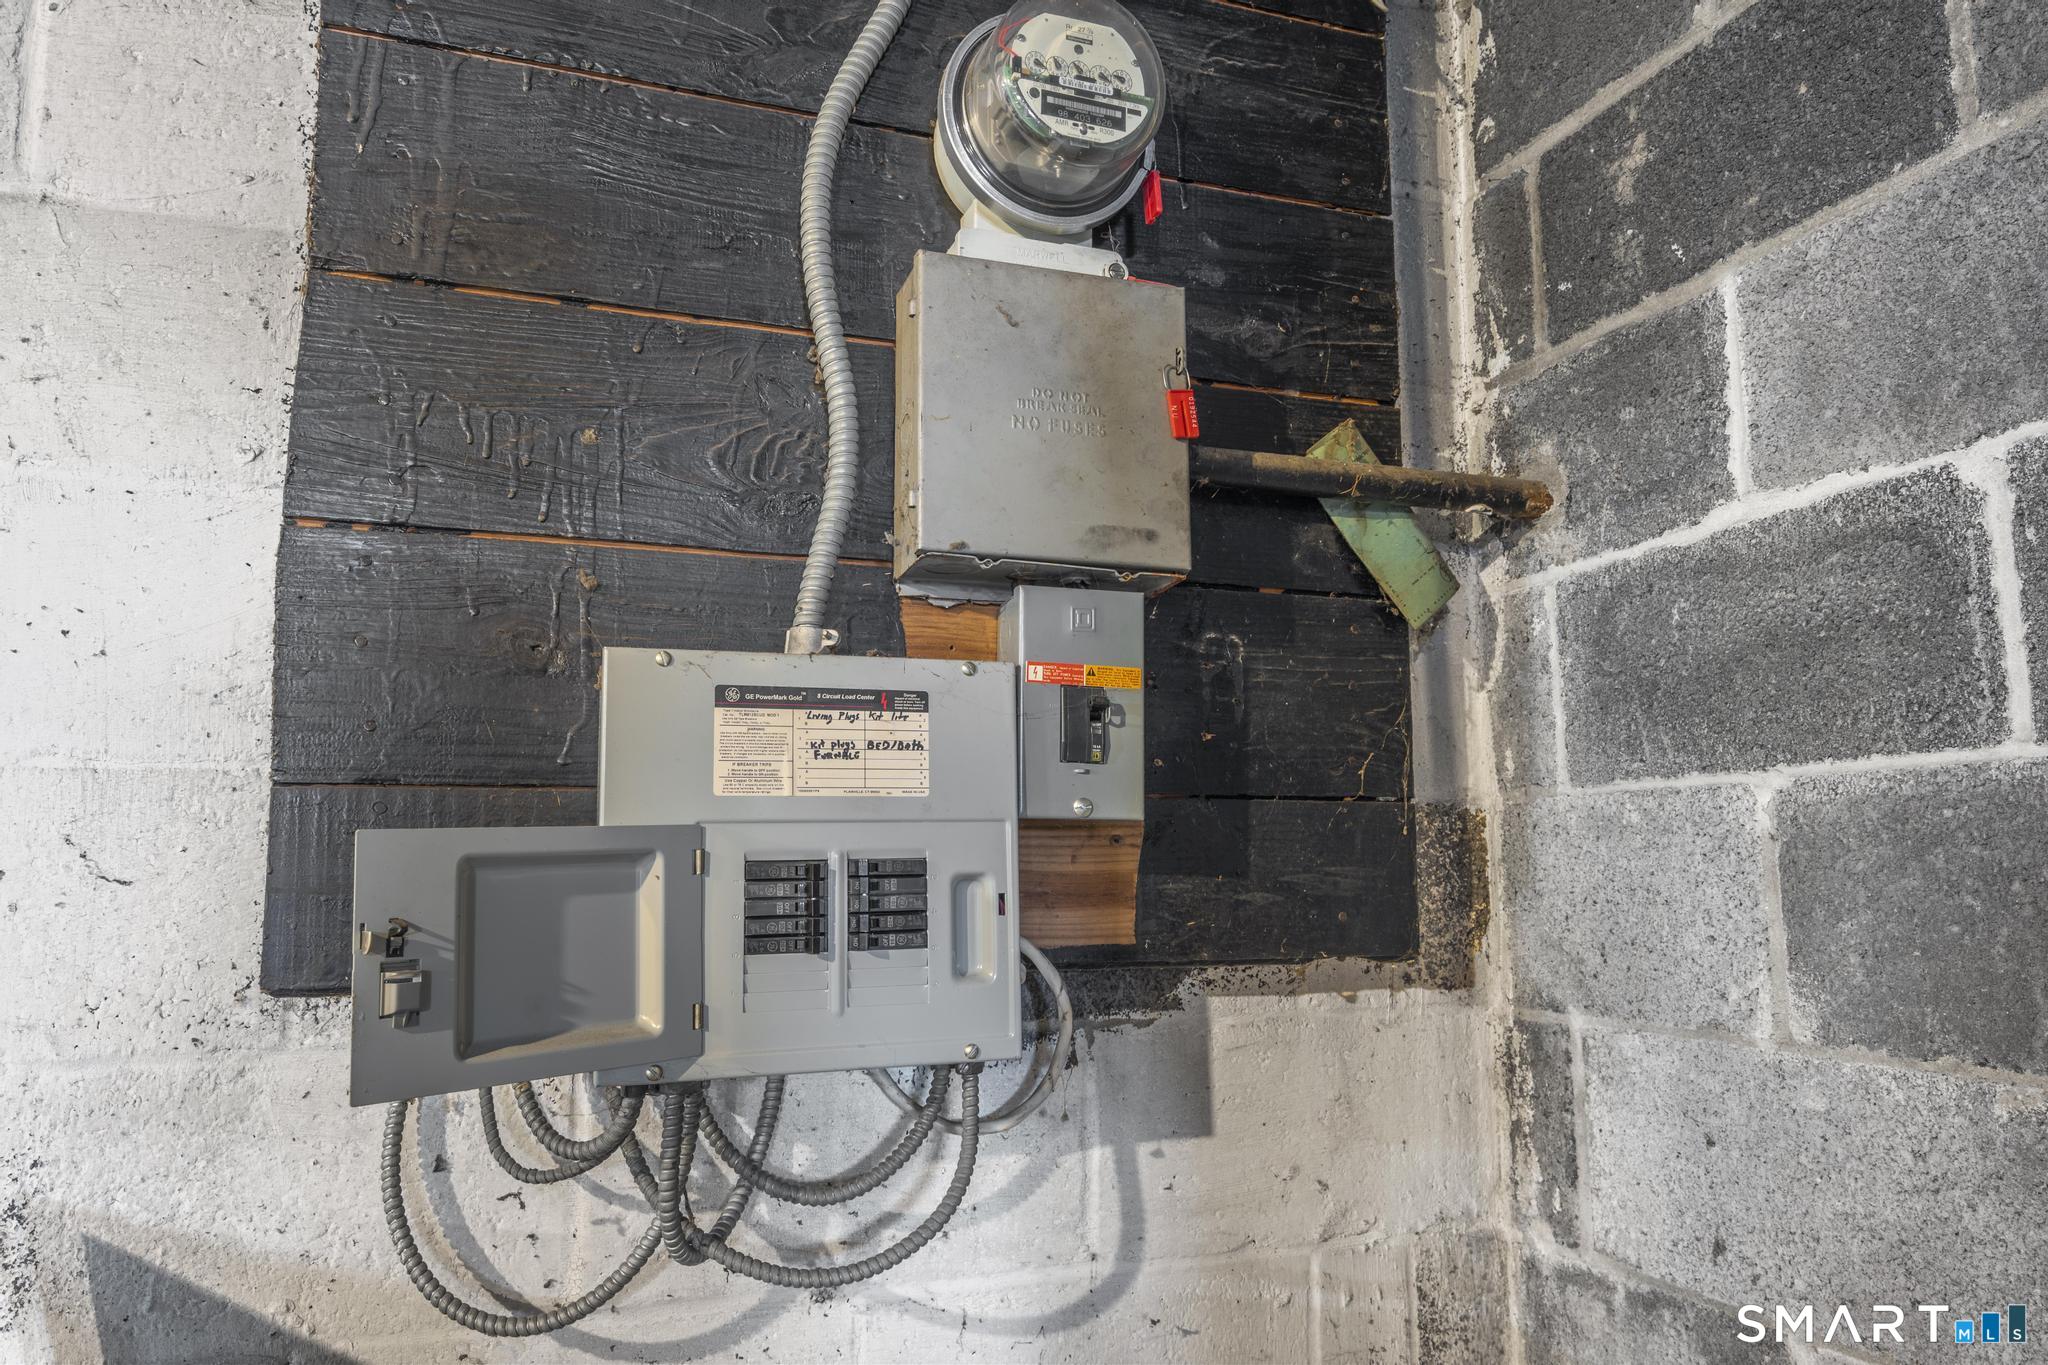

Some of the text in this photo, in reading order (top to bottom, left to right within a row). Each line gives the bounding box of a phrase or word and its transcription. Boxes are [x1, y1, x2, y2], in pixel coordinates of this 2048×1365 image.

[1057, 109, 1113, 128] 98 403 626
[1031, 387, 1090, 403] DO NOT
[1016, 398, 1107, 418] BREAK SEAL
[1011, 414, 1107, 438] NO FUSES
[838, 711, 860, 723] Plugs
